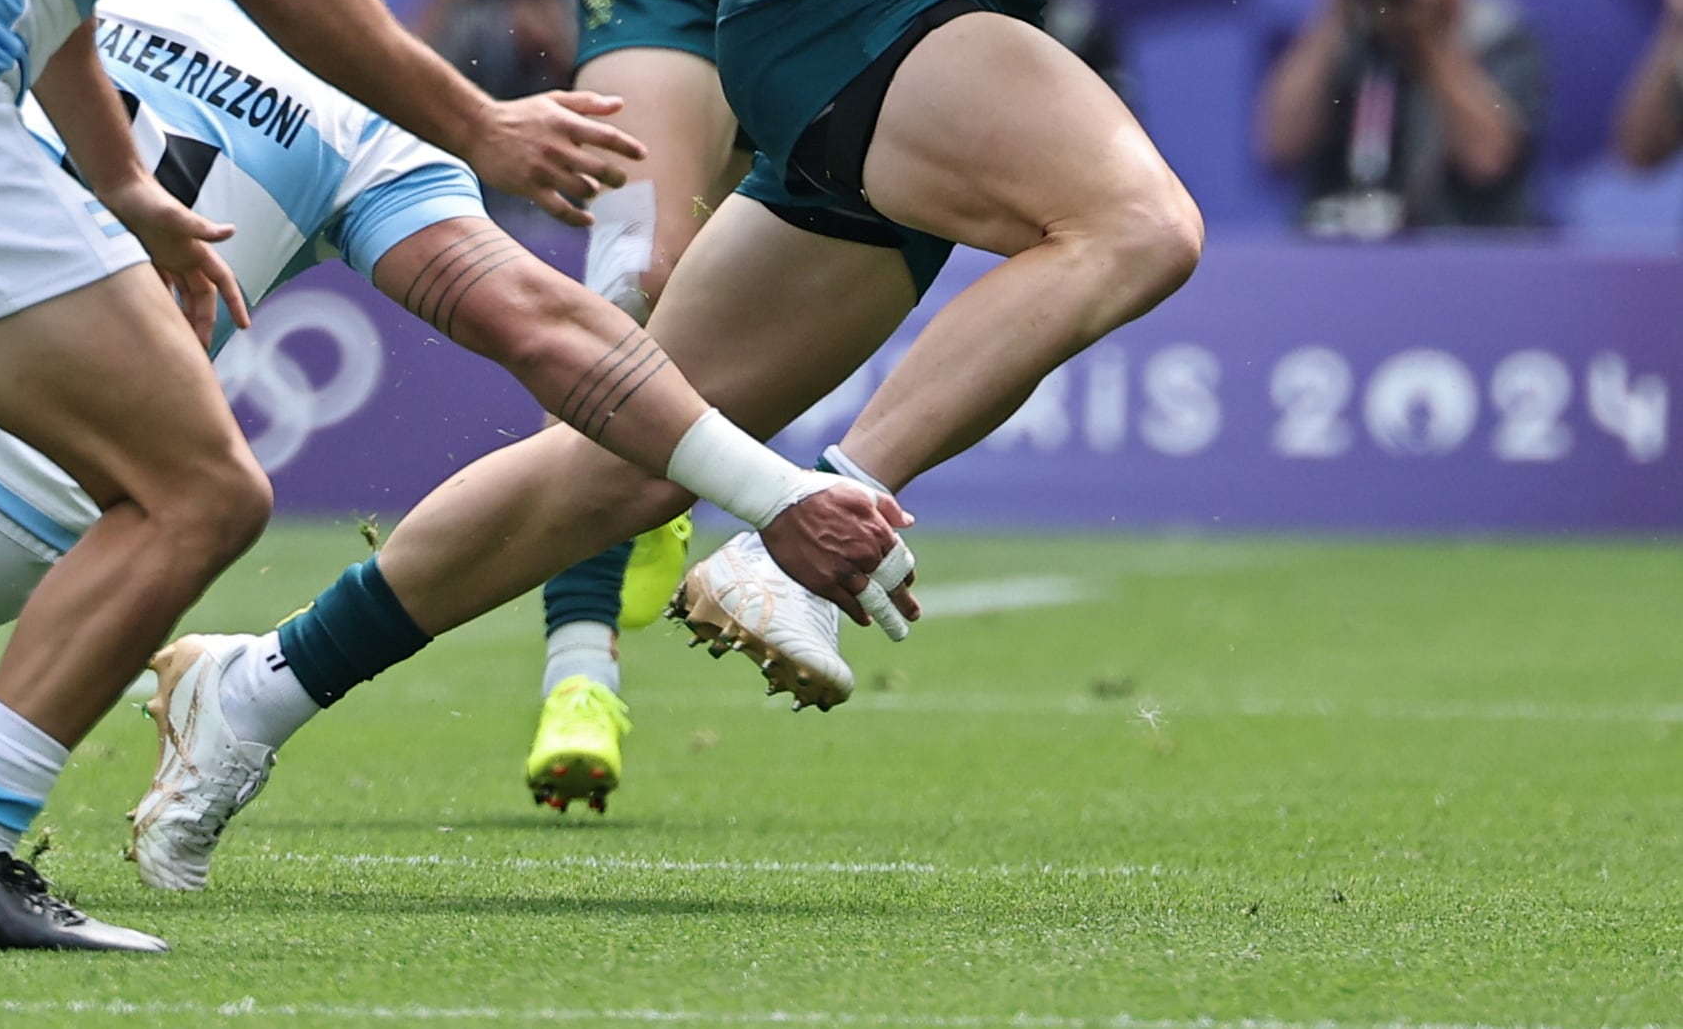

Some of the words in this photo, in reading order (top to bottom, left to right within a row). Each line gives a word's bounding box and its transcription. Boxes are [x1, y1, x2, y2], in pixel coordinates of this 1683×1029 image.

[97, 18, 188, 83] ALEZ
[174, 50, 310, 150] RIZZONI
[1269, 345, 1667, 463] 2024
